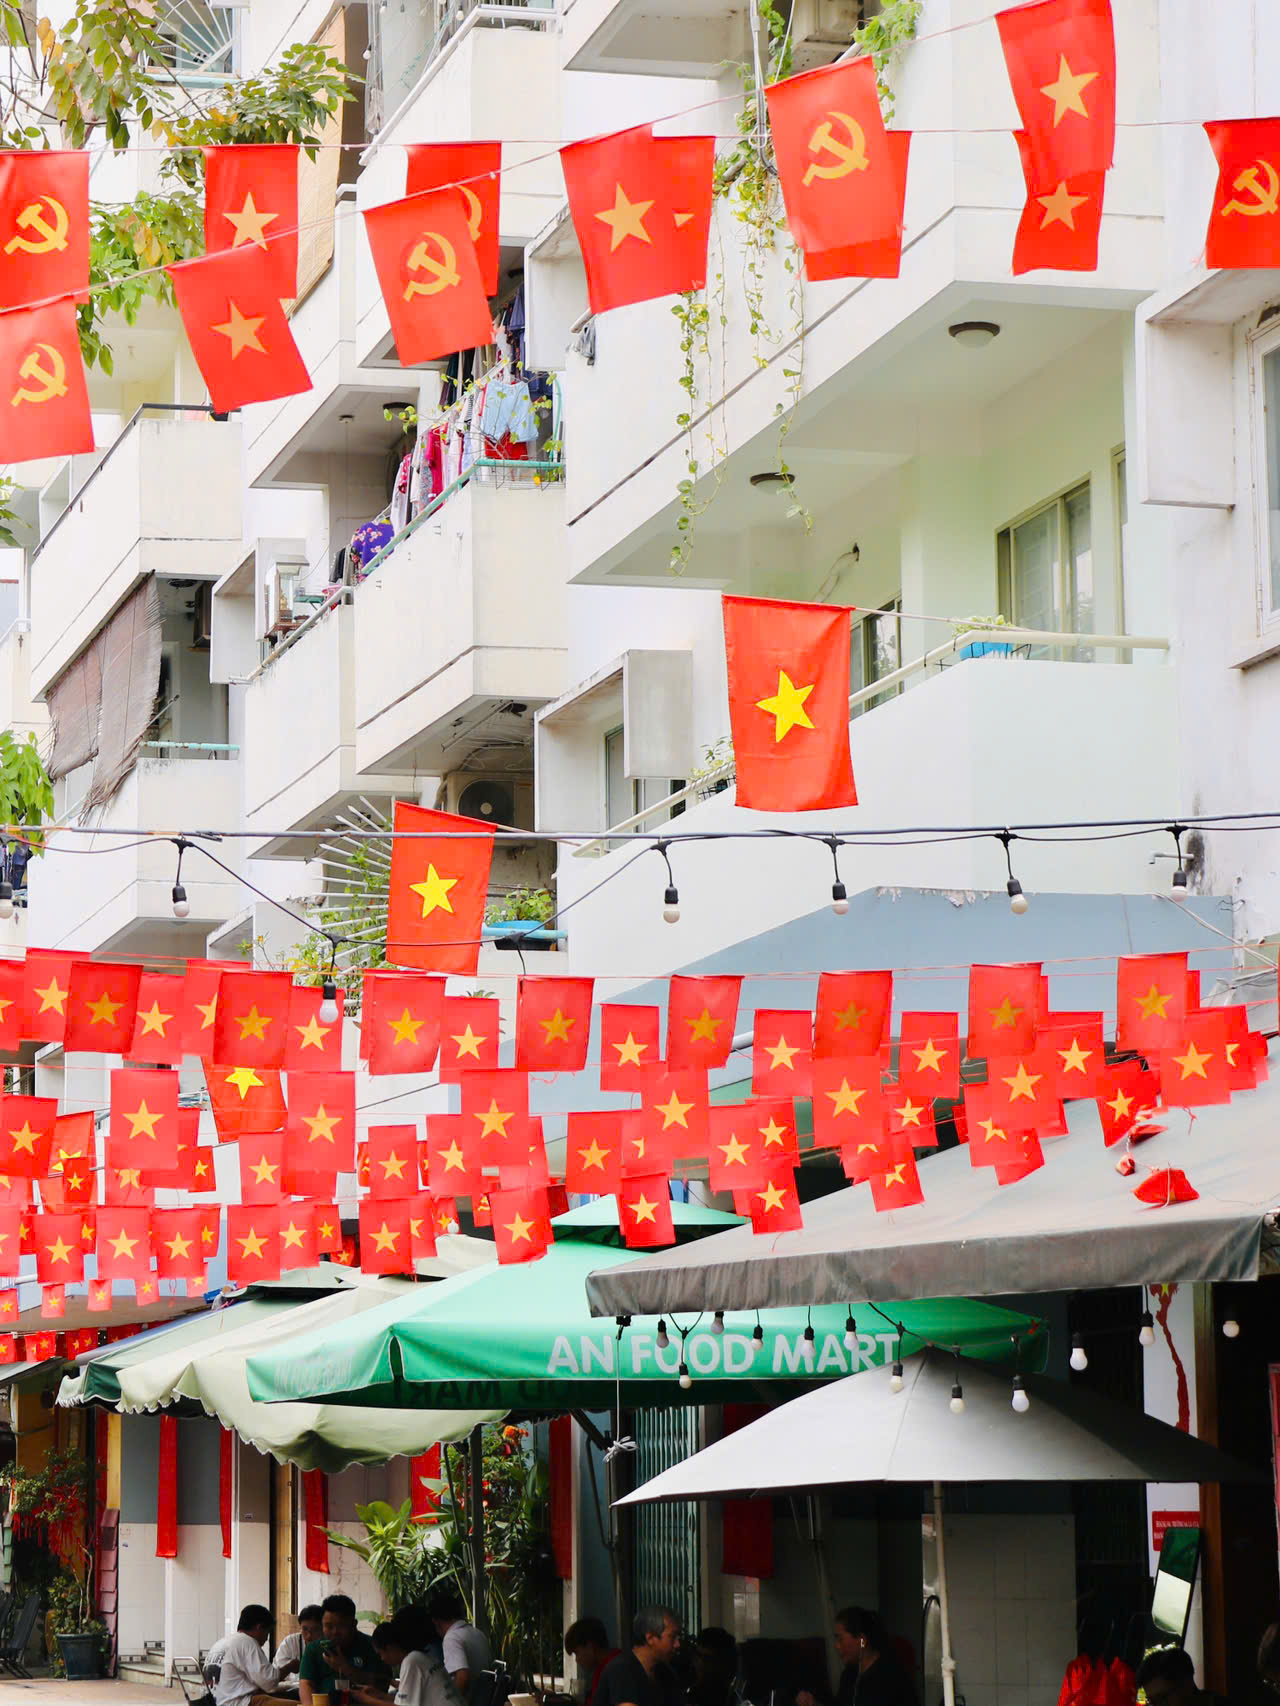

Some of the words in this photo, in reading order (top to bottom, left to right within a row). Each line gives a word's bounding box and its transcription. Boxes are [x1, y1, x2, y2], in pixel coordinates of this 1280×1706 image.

[546, 1335, 614, 1374] AN
[631, 1334, 755, 1374] FOOD
[772, 1333, 900, 1374] MART
